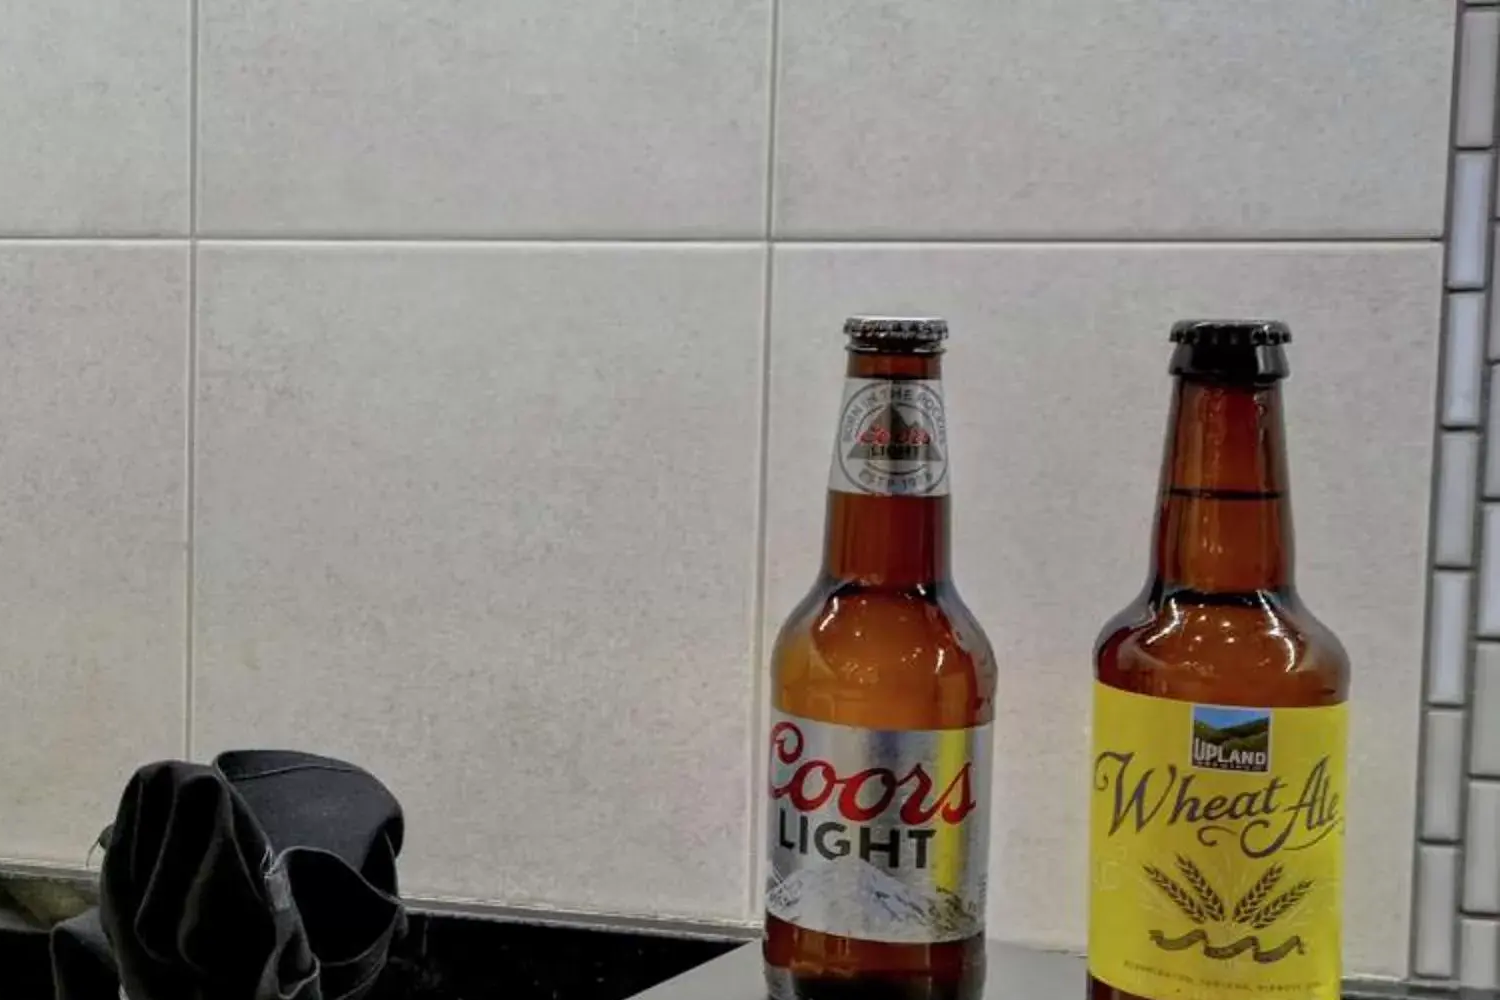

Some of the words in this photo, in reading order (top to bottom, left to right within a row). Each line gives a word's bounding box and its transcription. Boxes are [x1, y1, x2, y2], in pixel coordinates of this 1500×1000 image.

[771, 721, 976, 825] Coors
[1194, 737, 1267, 765] UPLAND
[779, 808, 937, 868] LIGHT
[1094, 751, 1288, 838] Wheat
[1240, 754, 1342, 859] Ale
